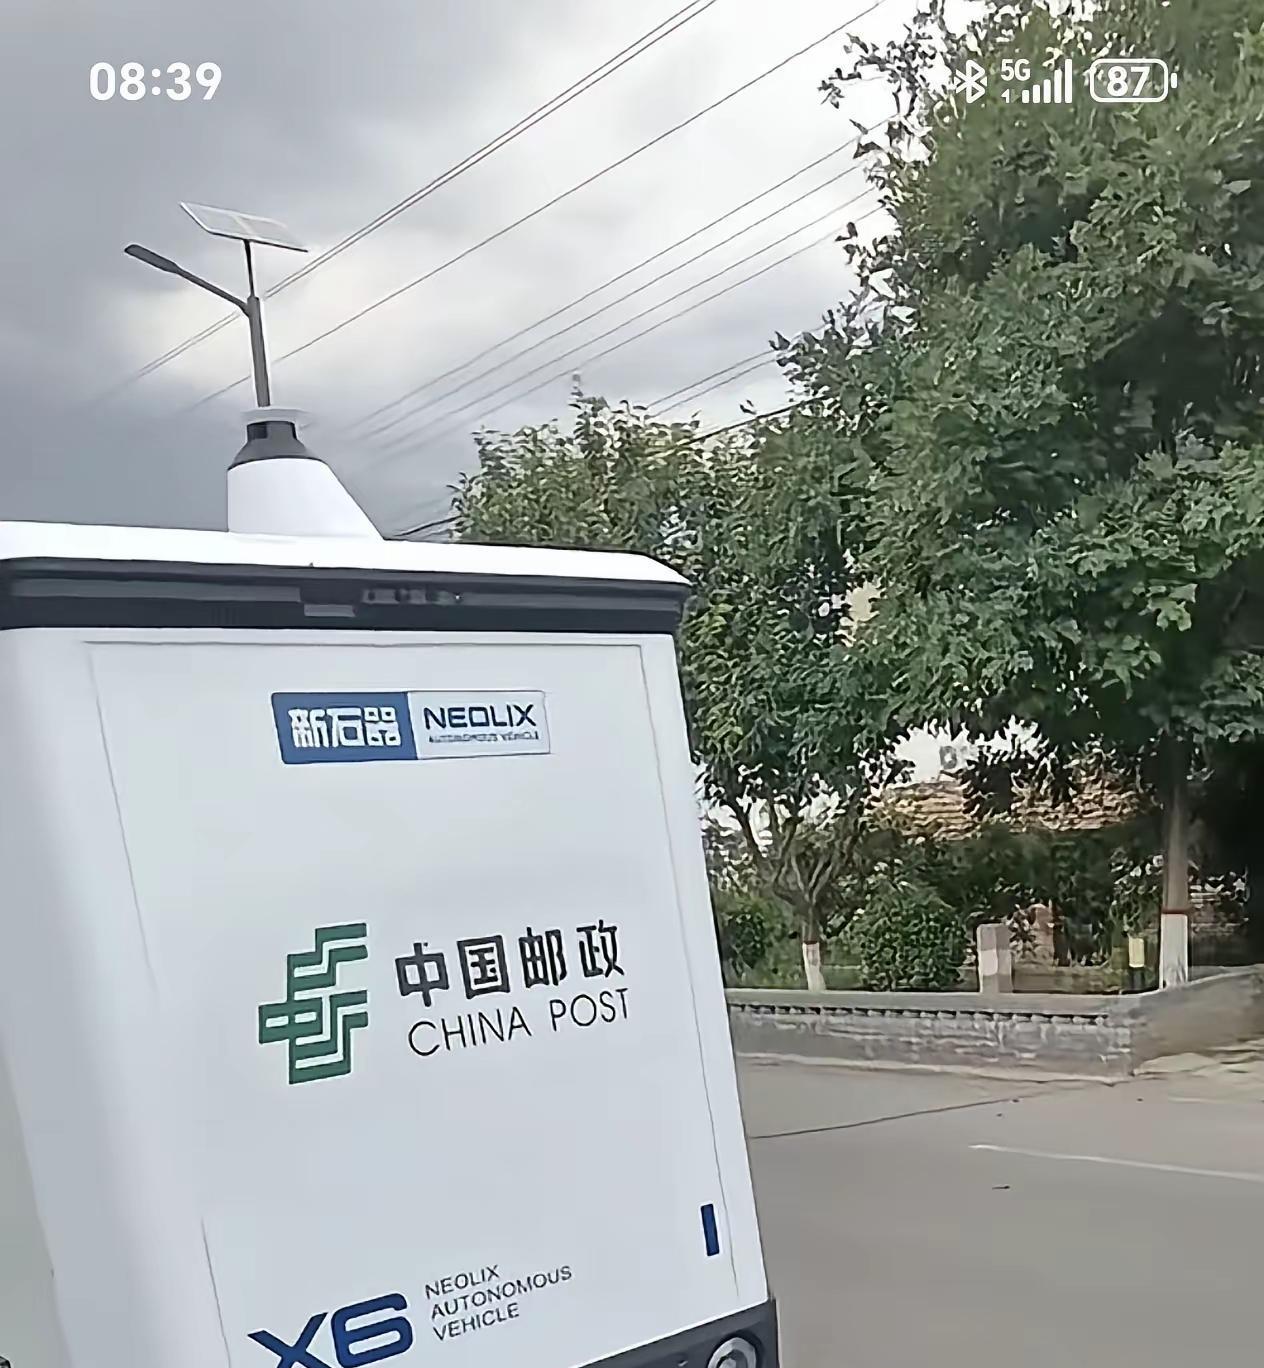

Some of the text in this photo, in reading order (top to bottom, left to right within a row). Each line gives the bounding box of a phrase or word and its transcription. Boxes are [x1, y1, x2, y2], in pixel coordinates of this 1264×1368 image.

[288, 706, 401, 748] 新石器
[423, 703, 537, 730] NEOLIX
[394, 919, 625, 1008] 中国邮政
[407, 987, 629, 1057] CHINA POST
[424, 1264, 501, 1300] NEOLIX
[431, 1265, 573, 1320] AUTONOMOUS
[433, 1302, 520, 1342] VEHICLE
